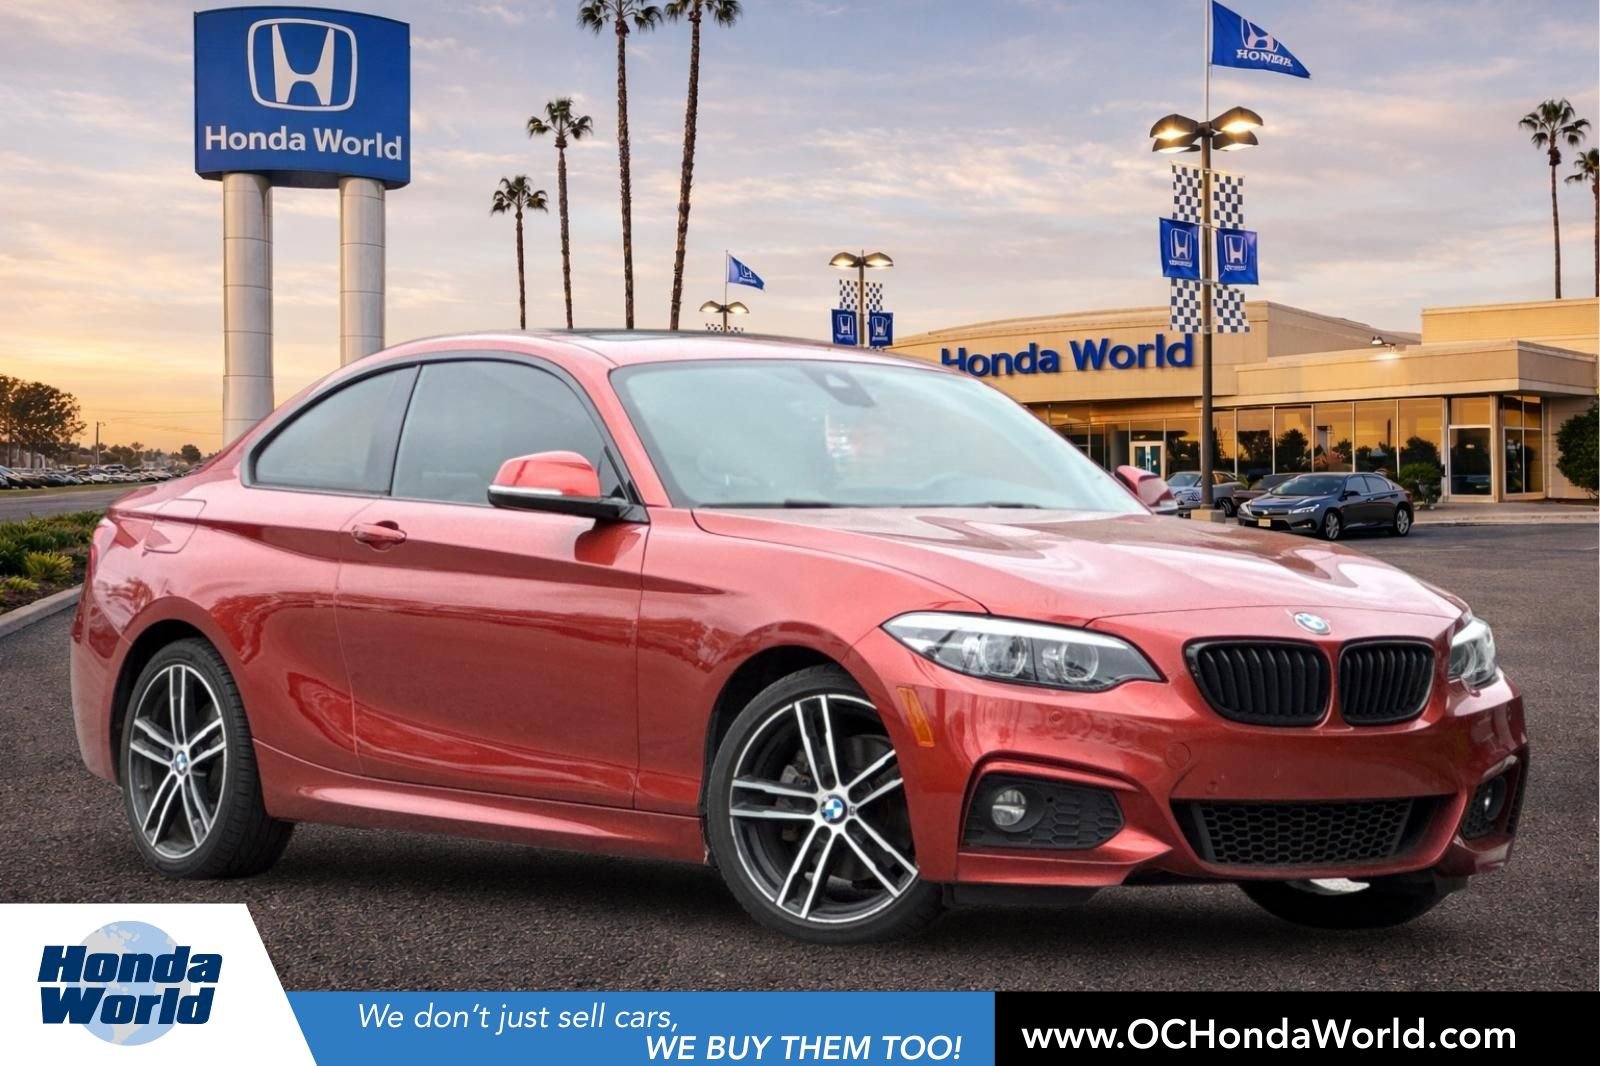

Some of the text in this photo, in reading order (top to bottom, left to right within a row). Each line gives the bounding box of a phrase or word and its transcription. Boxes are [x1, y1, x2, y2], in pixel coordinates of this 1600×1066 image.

[205, 125, 402, 161] Honda World
[941, 333, 1194, 377] Honda World
